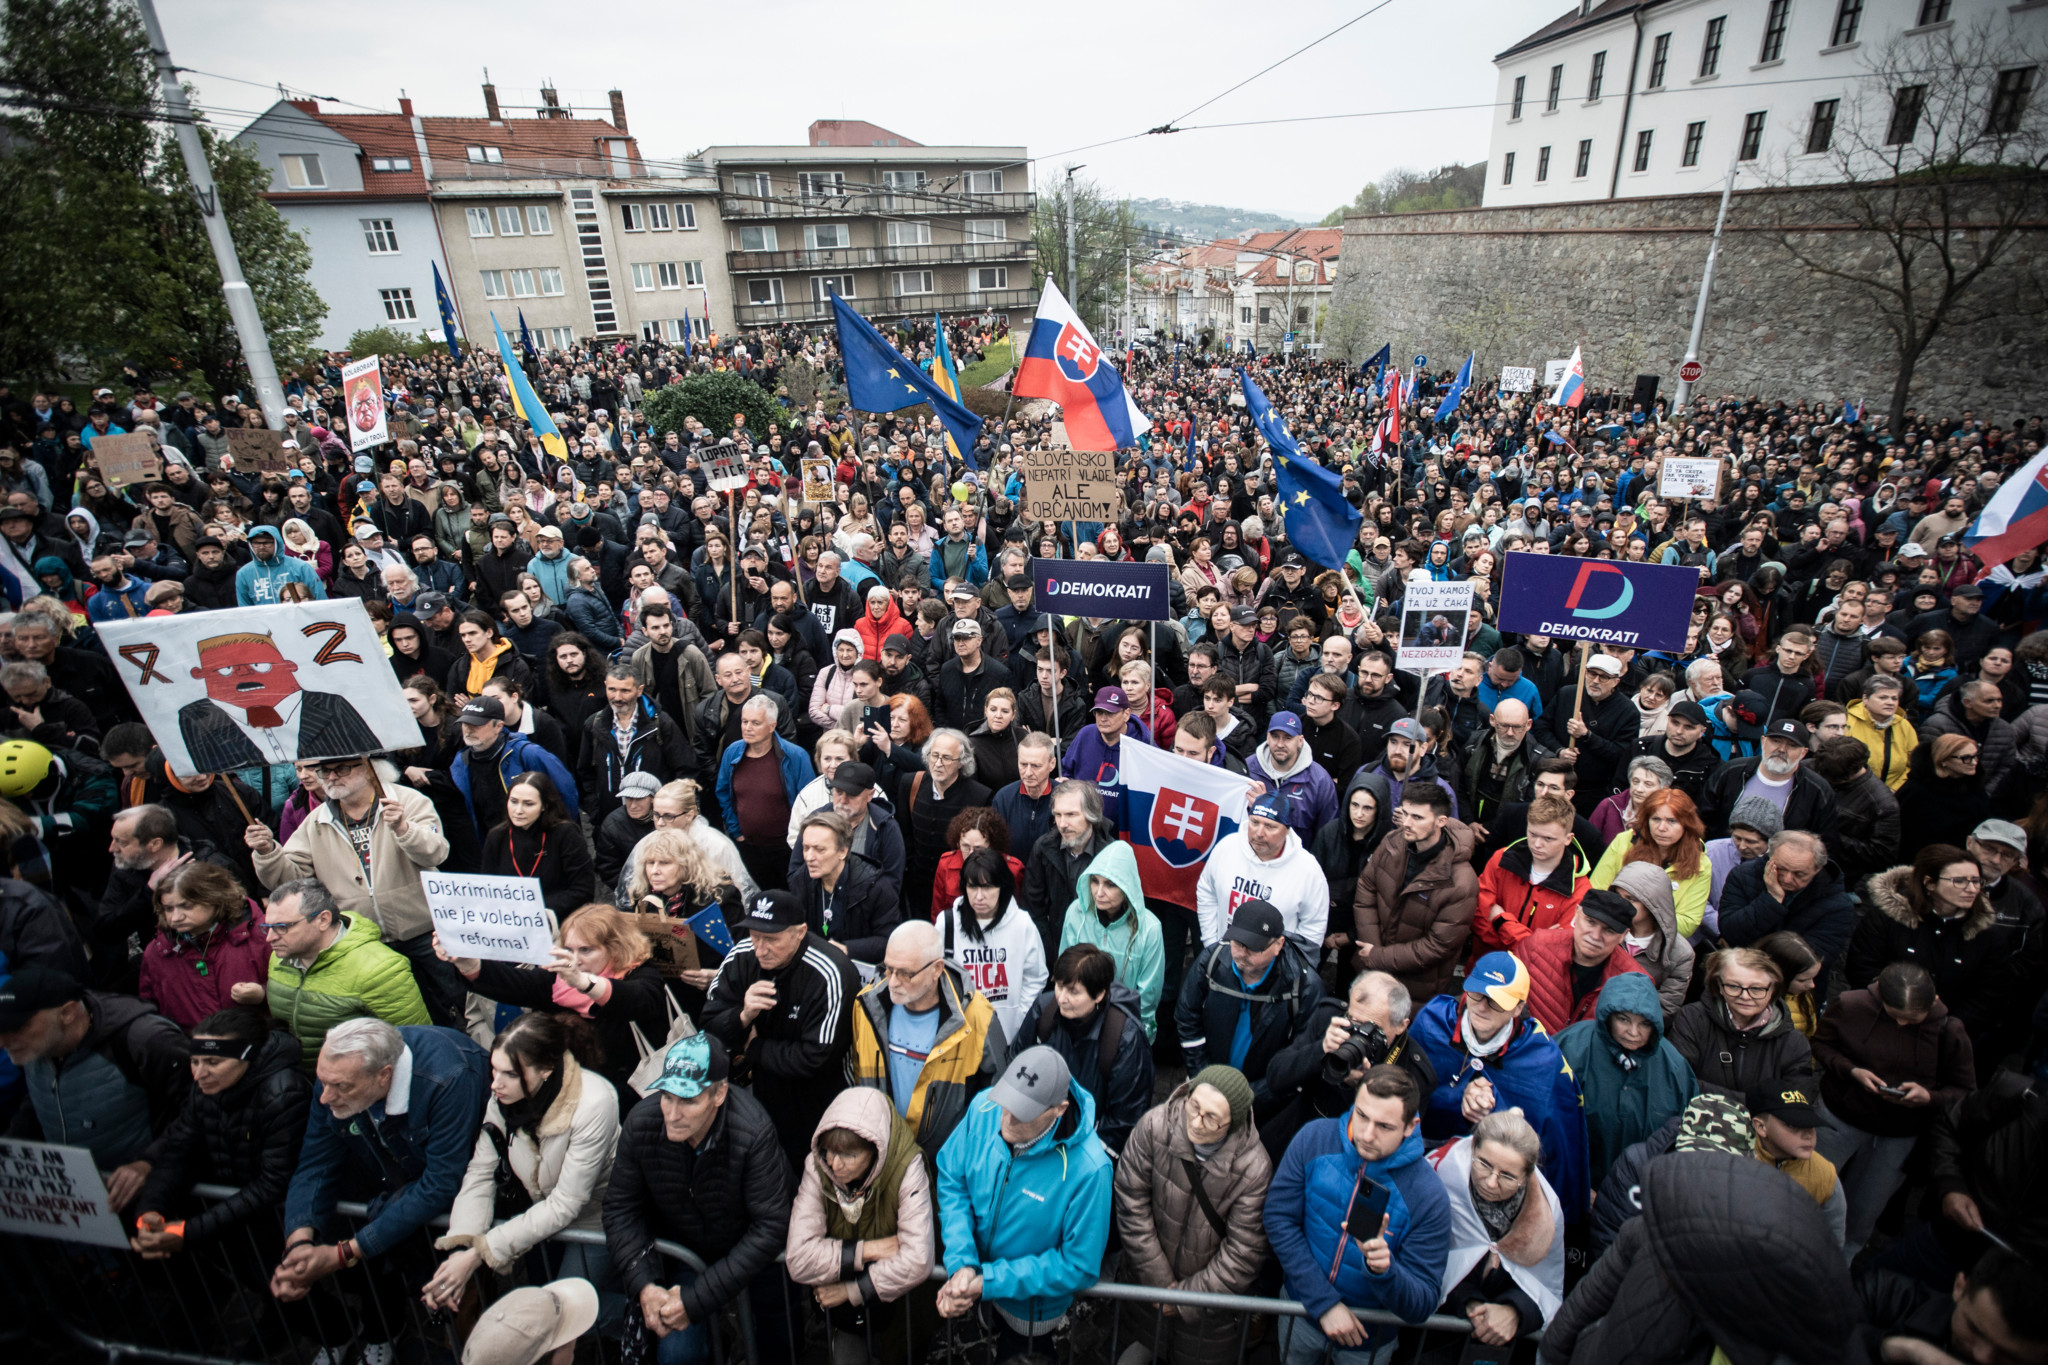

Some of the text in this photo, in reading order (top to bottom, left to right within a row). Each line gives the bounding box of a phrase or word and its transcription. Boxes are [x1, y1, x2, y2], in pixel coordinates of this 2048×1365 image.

[344, 360, 376, 377] KOLABORANT
[1681, 367, 1701, 376] STOP
[369, 432, 386, 442] TROLL
[700, 444, 740, 462] LOPATA
[715, 458, 732, 467] PRE
[712, 465, 746, 480] FICA
[1028, 467, 1114, 483] NEPATRÍ VLÁDE,
[1052, 483, 1091, 500] ALE
[1032, 499, 1112, 520] OBČANOM!
[1061, 581, 1151, 599] DEMOKRATI
[1410, 585, 1471, 595] TVOJ KAMOŠ
[1426, 598, 1438, 607] UŽ
[1444, 597, 1468, 608] ČAKÁ
[1539, 621, 1640, 644] DEMOKRATI
[1401, 648, 1458, 659] NEZDRŽUJ!
[1782, 722, 1795, 733] B
[428, 880, 536, 902] Diskriminácia
[433, 905, 544, 928] nie je volebná
[751, 910, 774, 920] adidas
[460, 931, 530, 950] reforma!
